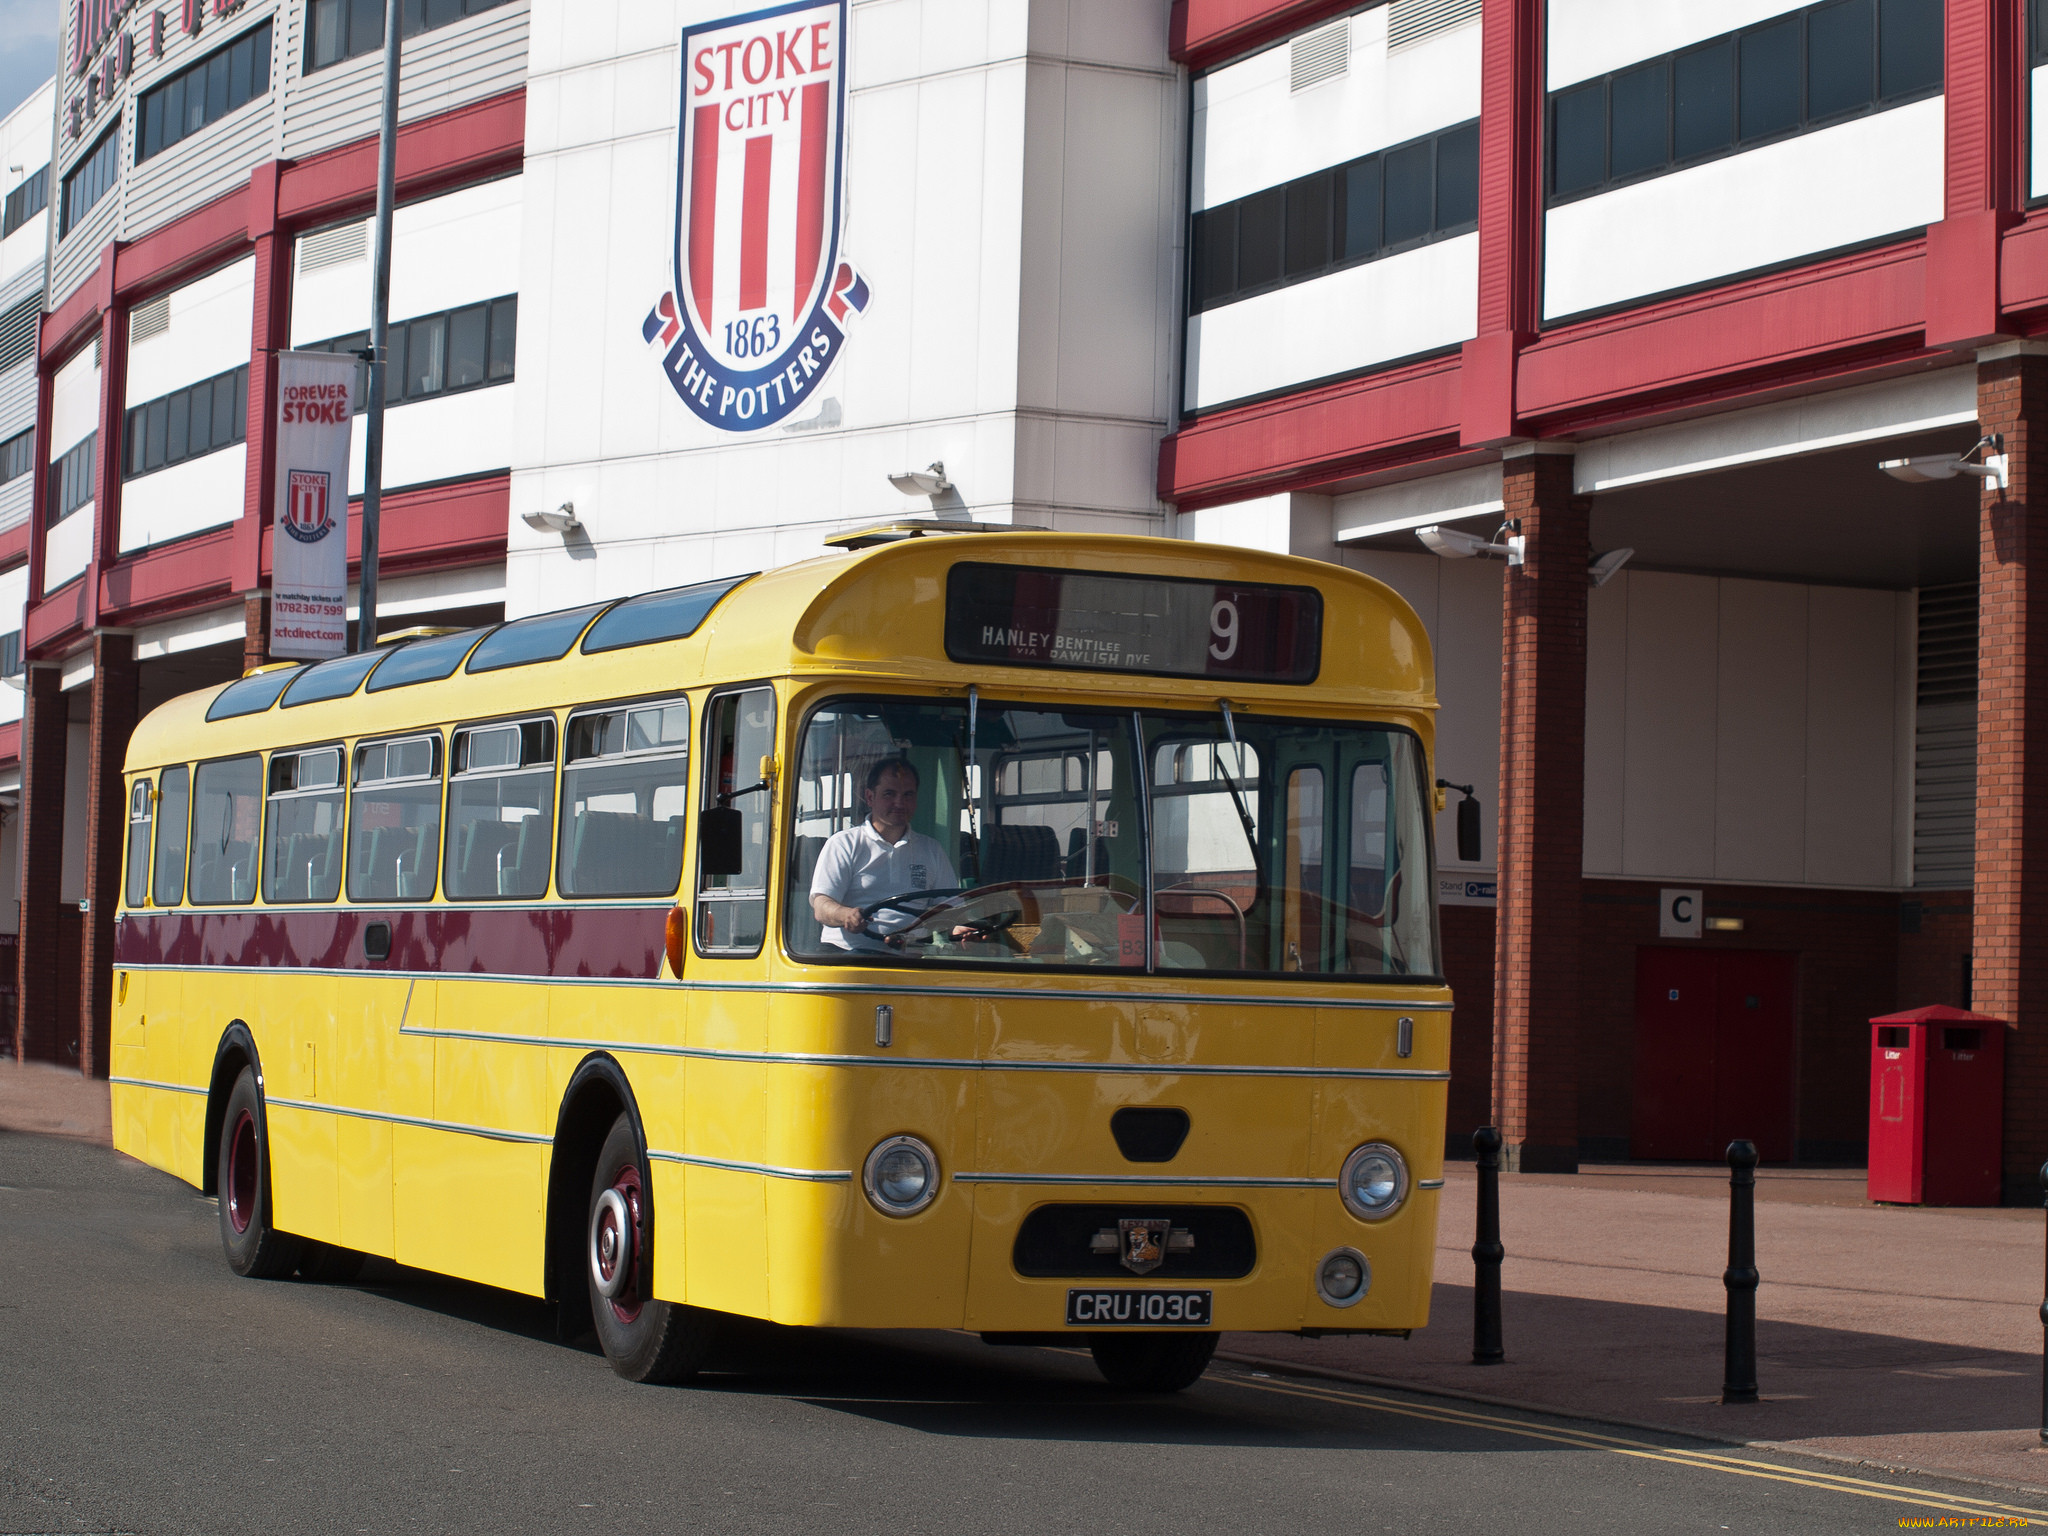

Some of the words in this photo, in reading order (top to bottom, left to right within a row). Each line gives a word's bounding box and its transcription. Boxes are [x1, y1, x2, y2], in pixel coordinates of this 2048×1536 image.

[693, 20, 833, 97] STOKE
[725, 87, 796, 133] CITY
[724, 313, 781, 360] 1863
[674, 342, 717, 409] THE
[719, 326, 831, 420] POTTERS
[283, 383, 348, 400] FOREVER
[283, 400, 348, 424] STOKE
[291, 473, 327, 486] STOKE
[299, 484, 319, 493] CITY
[303, 604, 322, 615] 367
[323, 605, 343, 615] 599
[274, 626, 344, 640] scfcdirect.com
[981, 625, 1050, 648] HANLEY
[1055, 635, 1121, 653] BENTILEE
[1208, 599, 1240, 661] 9
[1016, 647, 1038, 656] VIA
[1440, 881, 1463, 890] Stand
[1672, 895, 1692, 923] C
[1885, 1050, 1901, 1060] Litter
[1952, 1053, 1975, 1061] Litter
[1075, 1294, 1131, 1321] CRU
[1139, 1295, 1203, 1321] 103C
